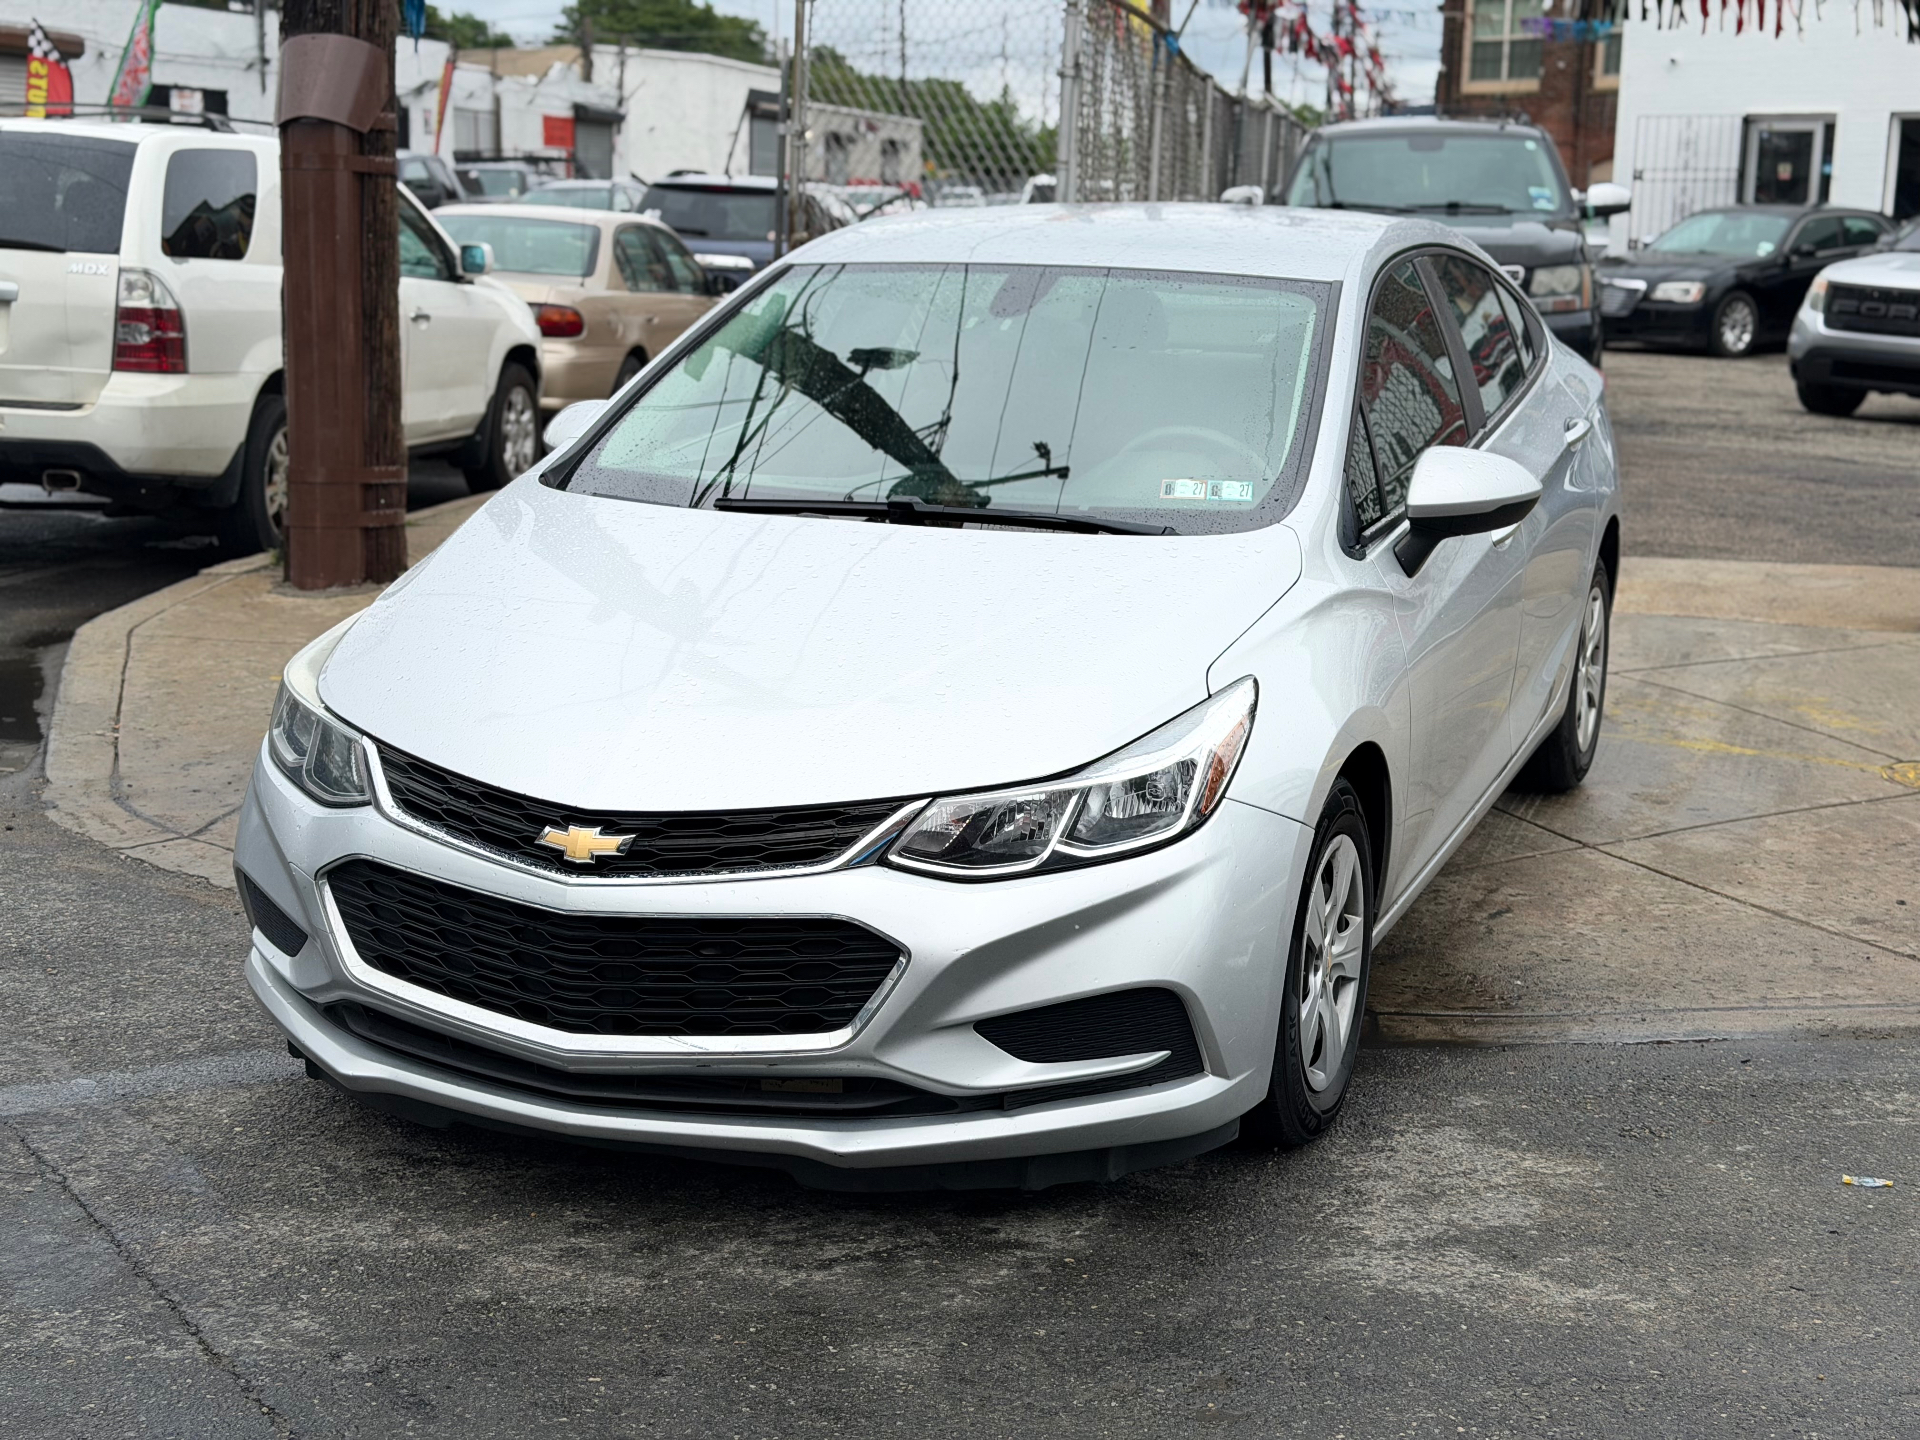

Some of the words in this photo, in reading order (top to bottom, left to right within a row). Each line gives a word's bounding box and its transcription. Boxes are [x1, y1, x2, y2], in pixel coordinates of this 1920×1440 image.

[66, 262, 109, 276] MDX
[1831, 299, 1920, 320] FOR
[1192, 482, 1204, 496] 27
[1239, 484, 1250, 498] 27
